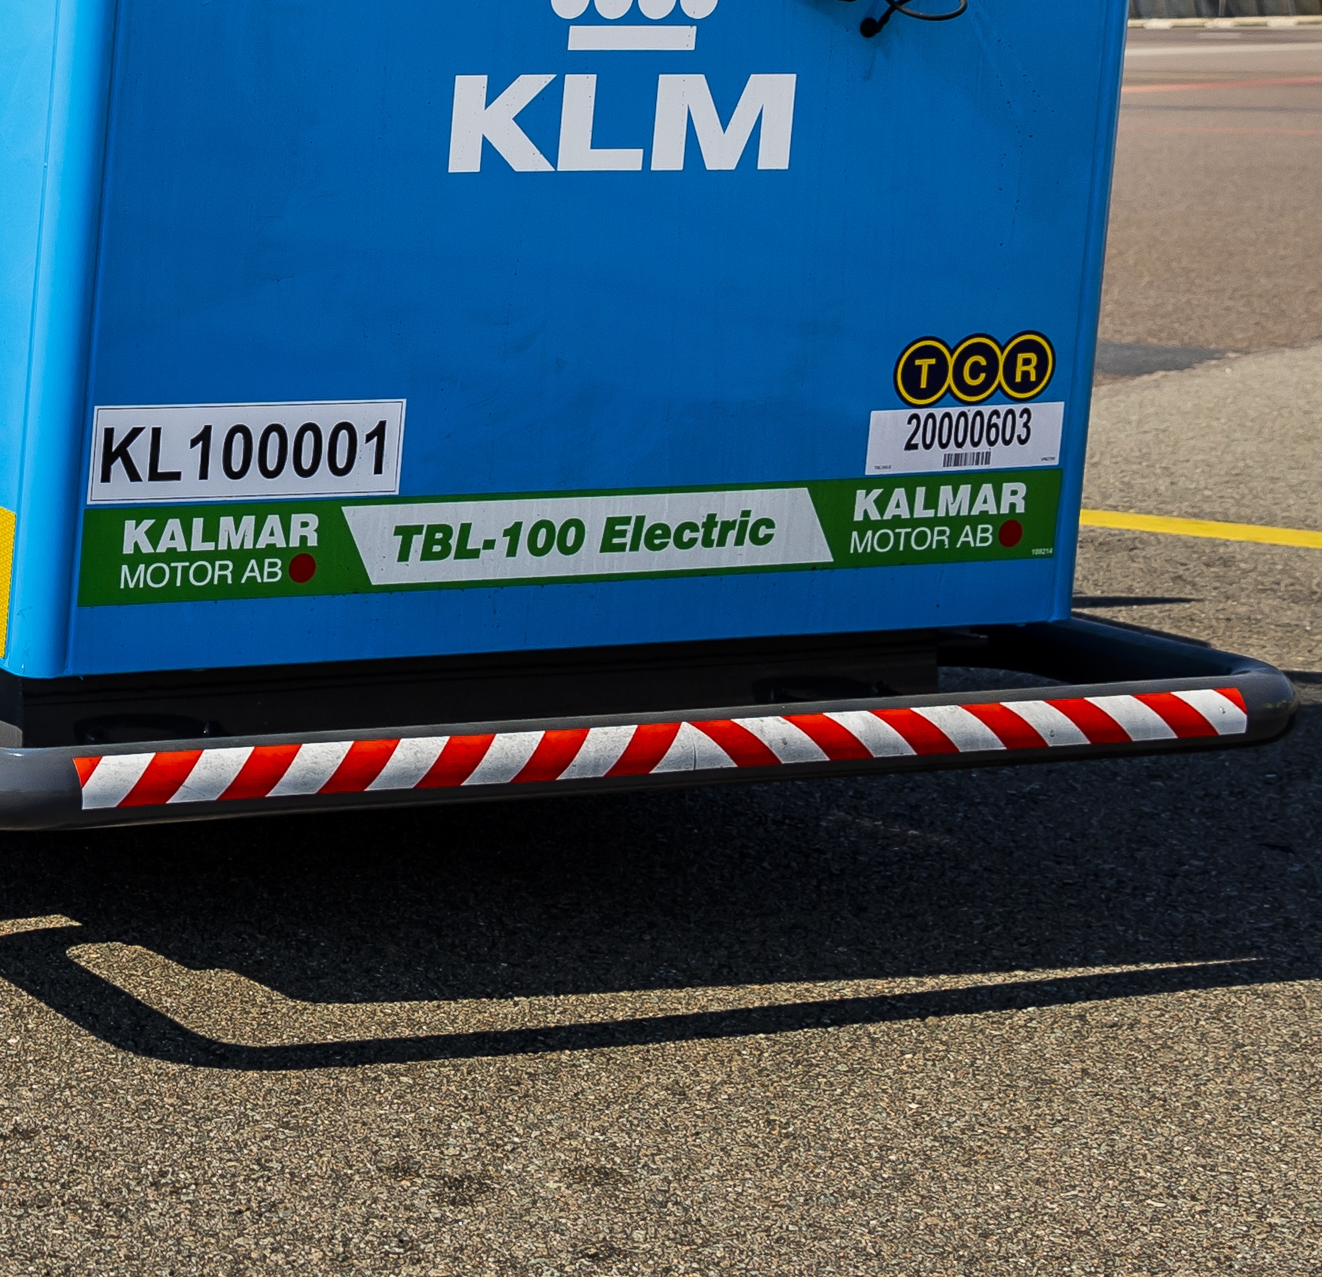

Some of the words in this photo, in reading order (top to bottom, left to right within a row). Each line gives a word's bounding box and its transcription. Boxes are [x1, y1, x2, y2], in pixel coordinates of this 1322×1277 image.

[448, 73, 797, 173] KLM
[904, 407, 1032, 451] 20000603
[853, 482, 1027, 522] KALMAR
[122, 513, 319, 555] KALMAR
[393, 517, 587, 563] TBL-100
[599, 509, 776, 554] Electric
[850, 526, 951, 554] MOTOR
[956, 524, 993, 548] AB
[119, 560, 233, 589] MOTOR
[240, 558, 283, 584] AB
